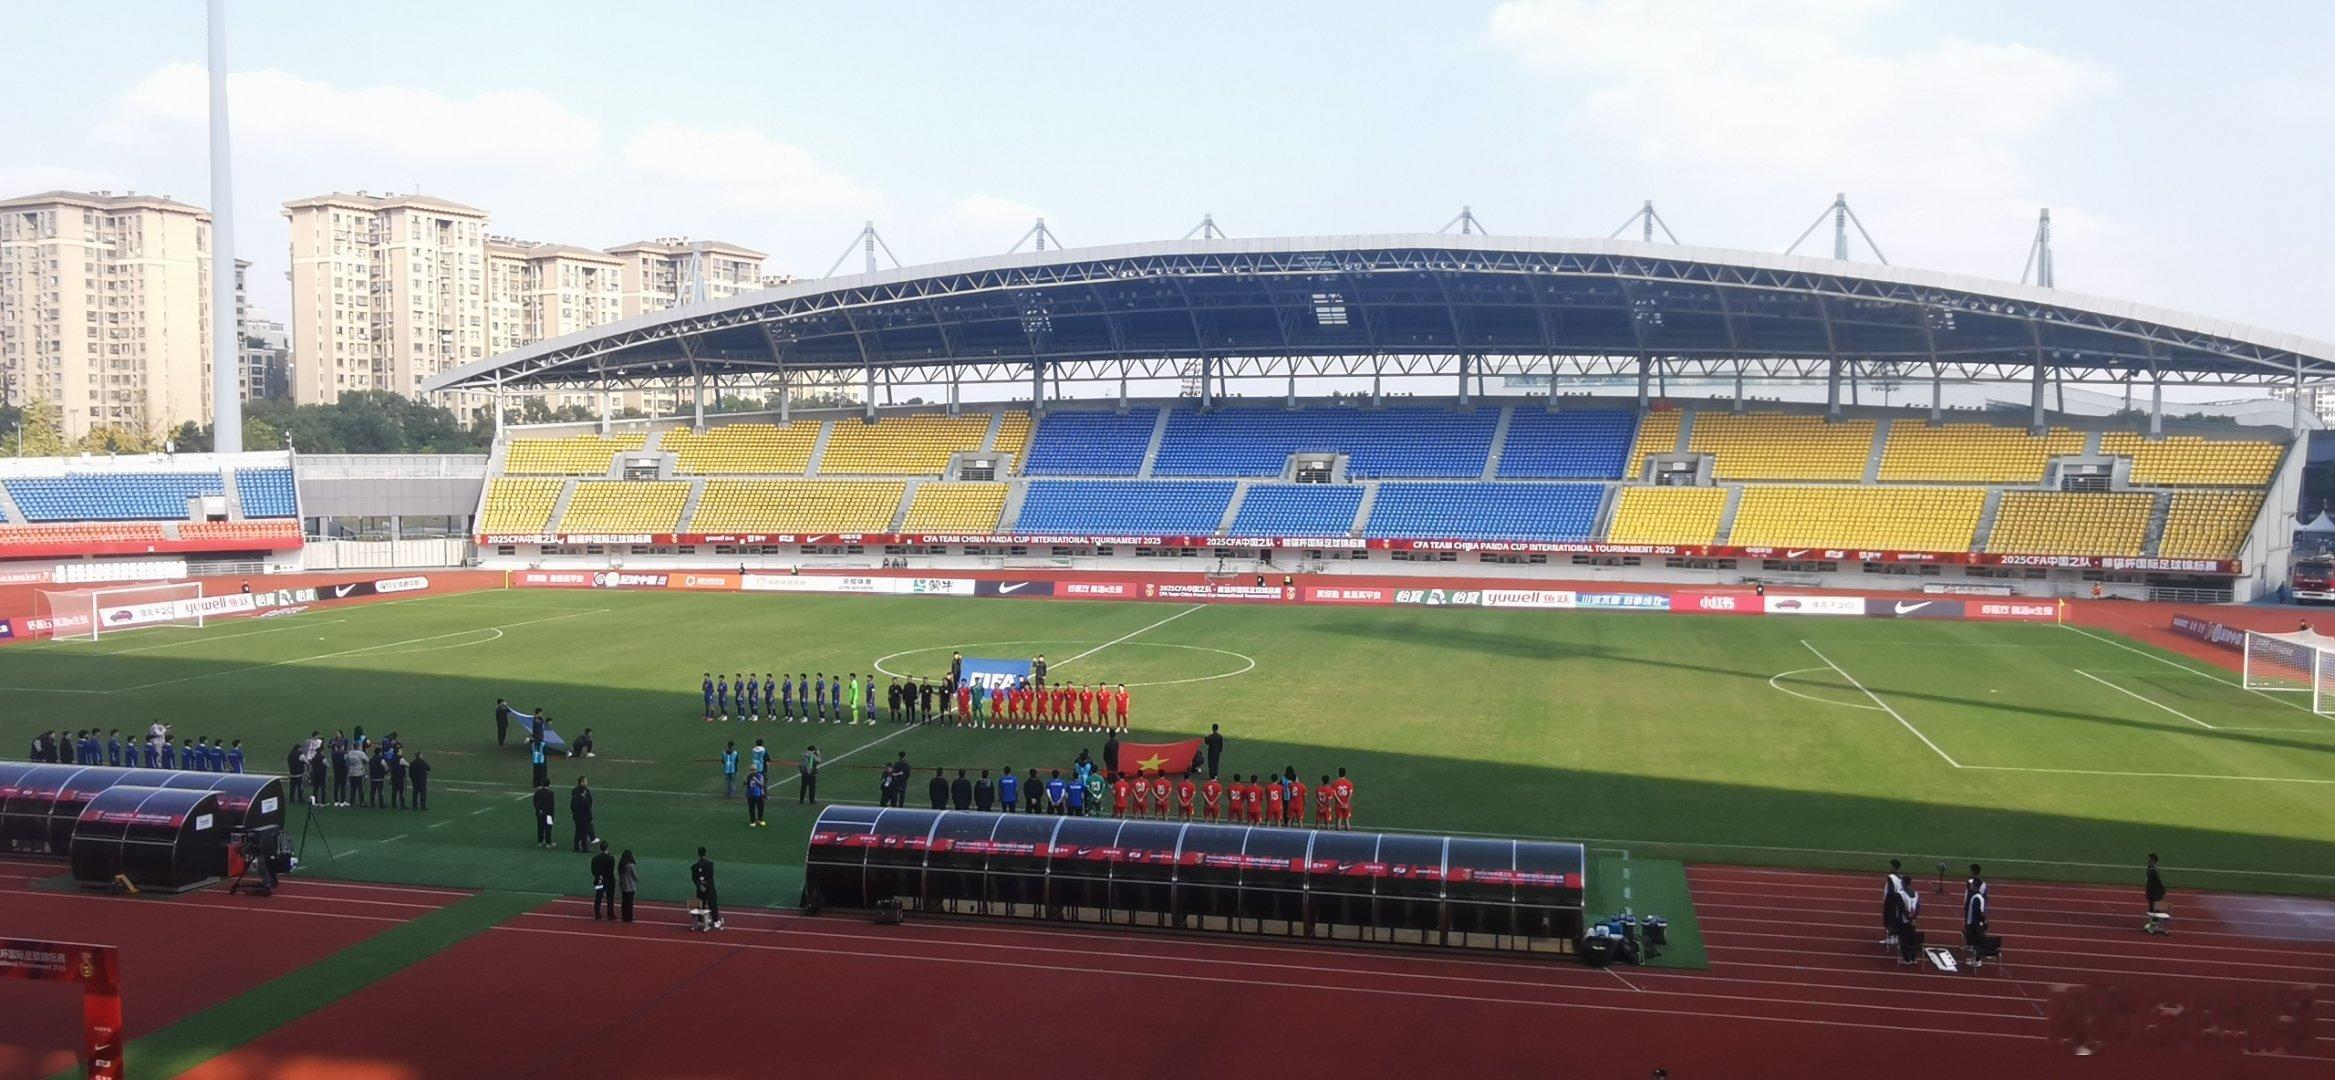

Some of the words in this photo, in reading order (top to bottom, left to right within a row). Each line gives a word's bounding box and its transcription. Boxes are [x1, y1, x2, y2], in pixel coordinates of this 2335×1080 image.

[922, 535, 938, 543] CFA
[939, 535, 960, 543] TEAM
[961, 535, 985, 543] CHINA
[986, 535, 1012, 543] PANDA
[1091, 536, 1142, 544] TOURNAMENT
[1144, 537, 1161, 545] 2025
[1412, 541, 1429, 549] CFA
[1430, 541, 1452, 549] TEAM
[1510, 543, 1527, 551] CUP
[1529, 544, 1594, 552] INTERNATIONAL
[1595, 545, 1653, 553] TOURNAMENT
[1654, 546, 1676, 554] 2025
[185, 596, 226, 616] yuwell
[1488, 592, 1541, 606] yuwell
[969, 671, 1016, 690] FIFA
